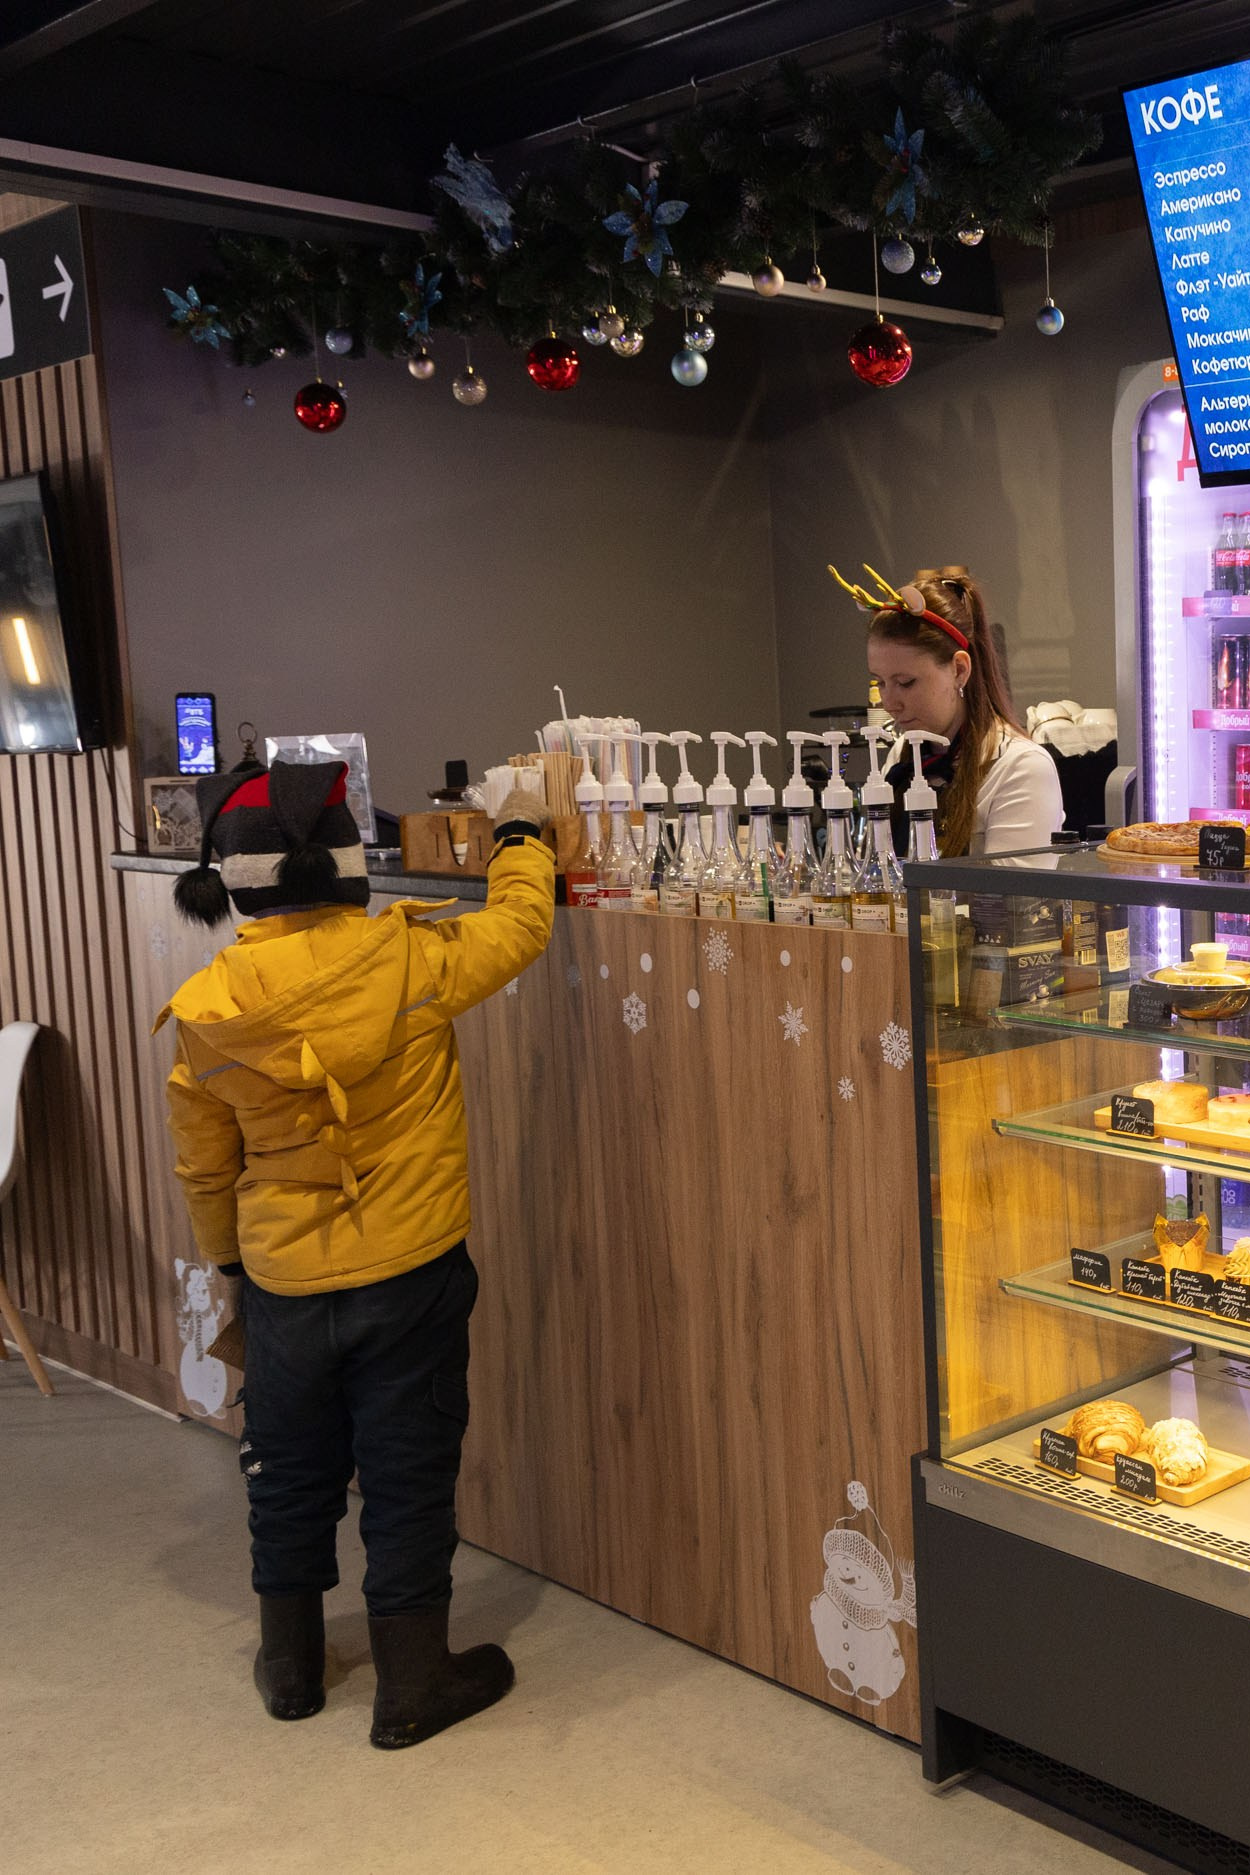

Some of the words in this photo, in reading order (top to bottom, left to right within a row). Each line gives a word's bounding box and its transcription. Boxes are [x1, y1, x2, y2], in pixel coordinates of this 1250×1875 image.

[1140, 84, 1223, 135] КОФЕ
[1153, 161, 1227, 189] Эспрессо
[1161, 187, 1242, 216] Американо
[1176, 279, 1210, 297] Флэт
[1181, 303, 1210, 323] Раф
